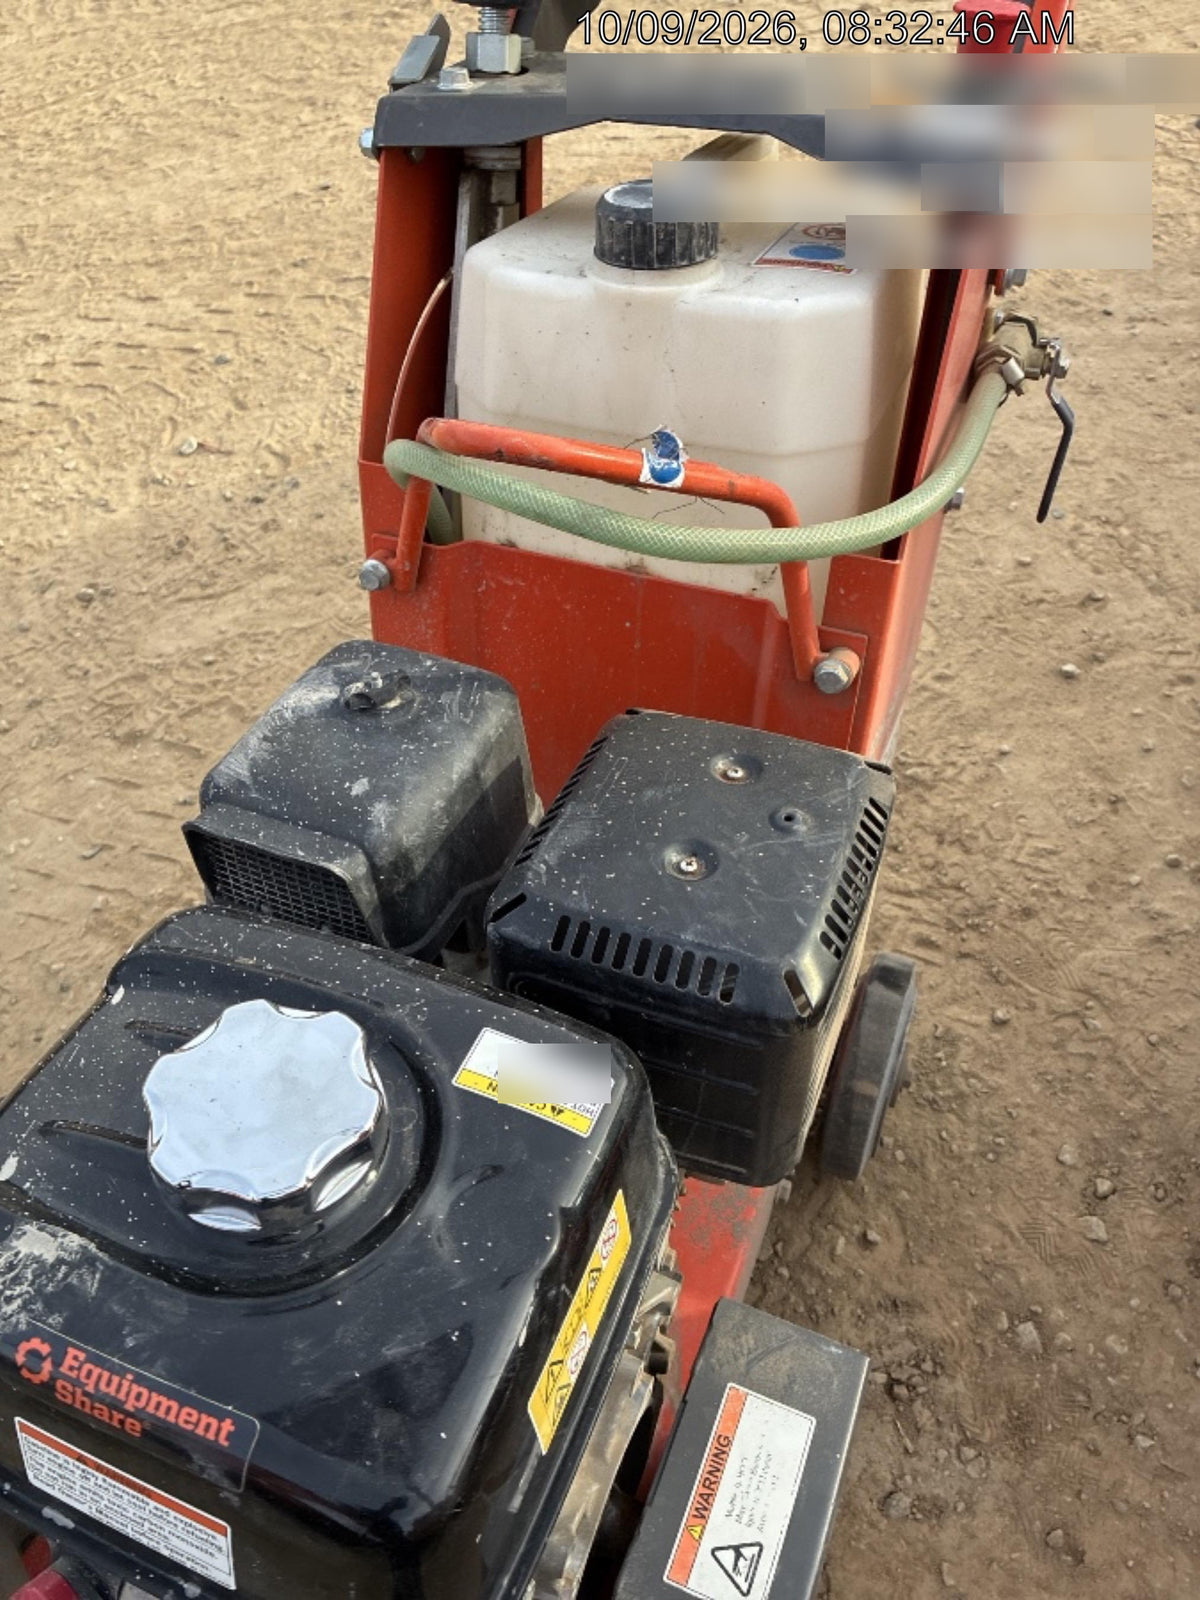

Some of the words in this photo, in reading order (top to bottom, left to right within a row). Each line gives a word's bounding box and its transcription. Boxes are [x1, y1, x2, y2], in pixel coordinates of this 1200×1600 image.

[54, 1378, 143, 1438] Share
[59, 1346, 235, 1447] Equipment
[692, 1434, 733, 1520] WARNING
